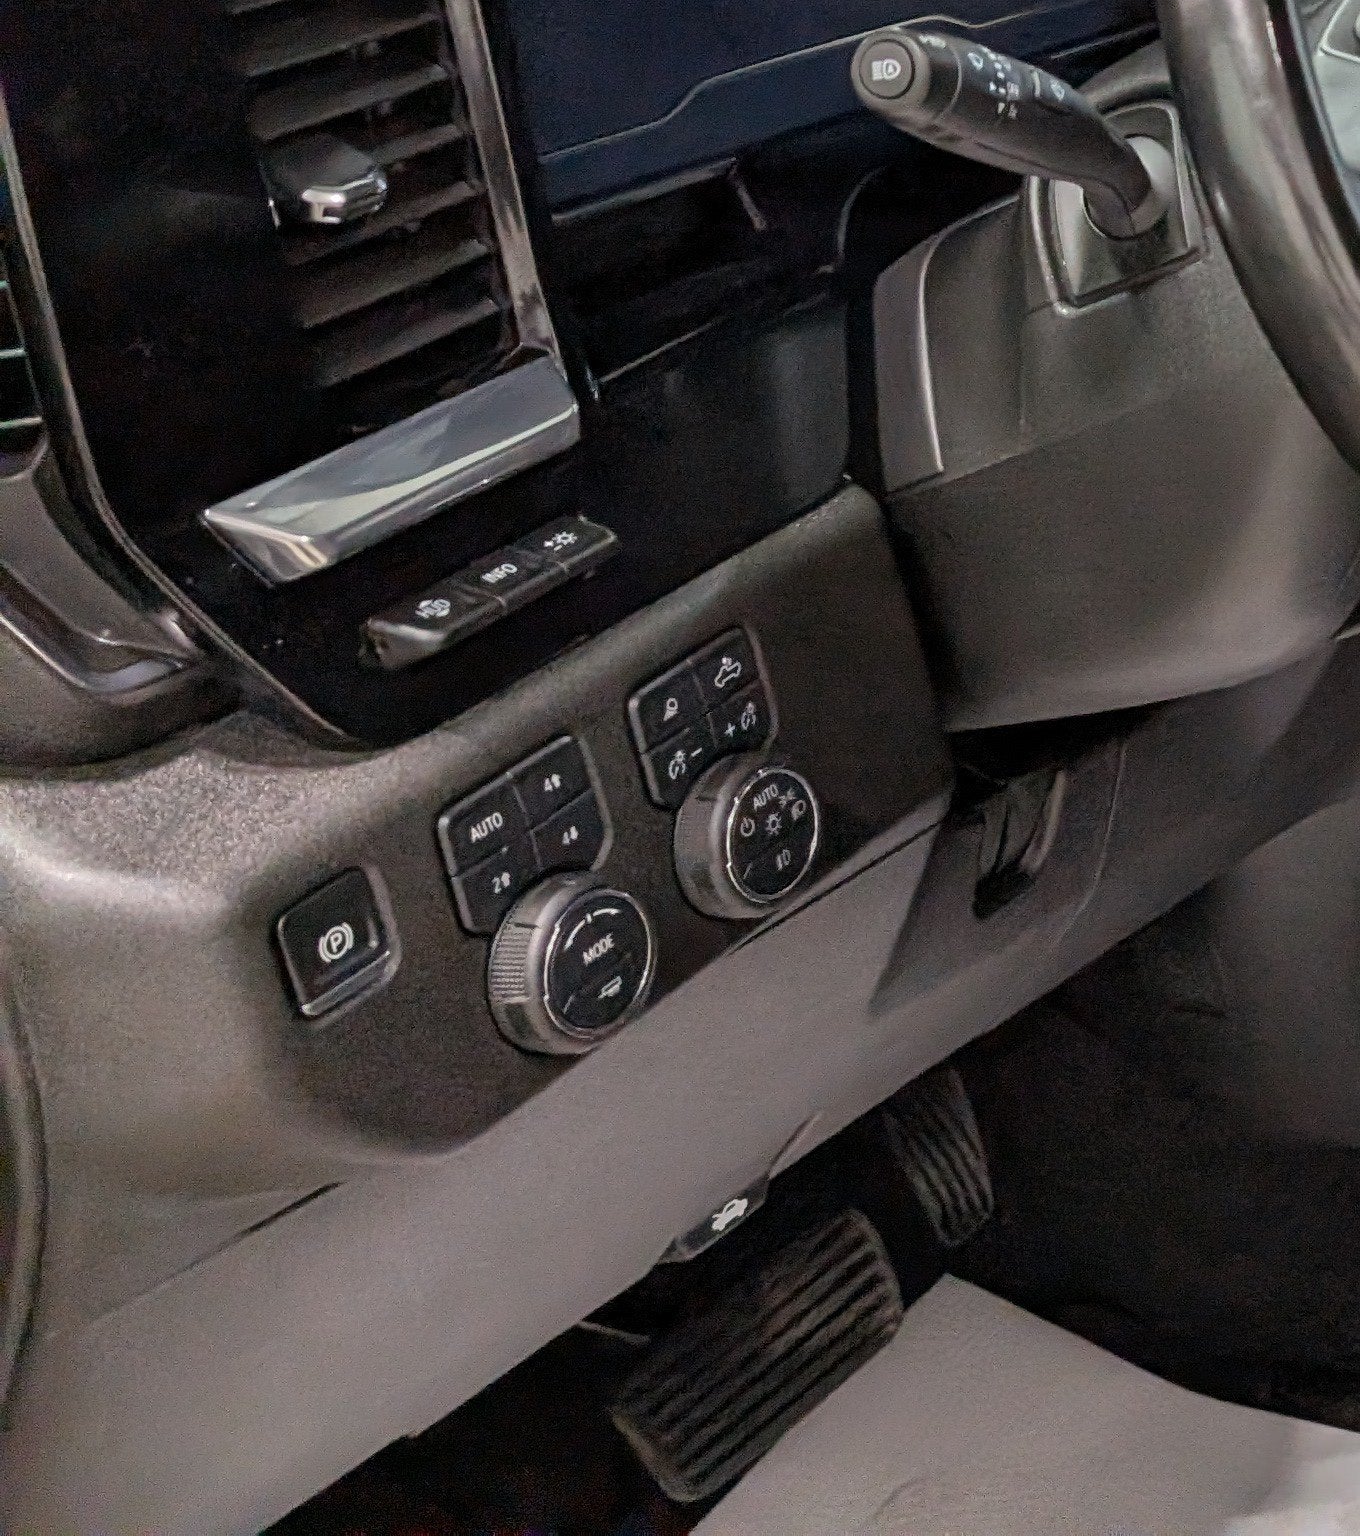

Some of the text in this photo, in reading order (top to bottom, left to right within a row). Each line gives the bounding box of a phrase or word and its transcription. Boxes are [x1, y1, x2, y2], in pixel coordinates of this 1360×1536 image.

[753, 784, 779, 811] AUTO
[470, 812, 503, 843] AUTO
[583, 932, 615, 966] MODE
